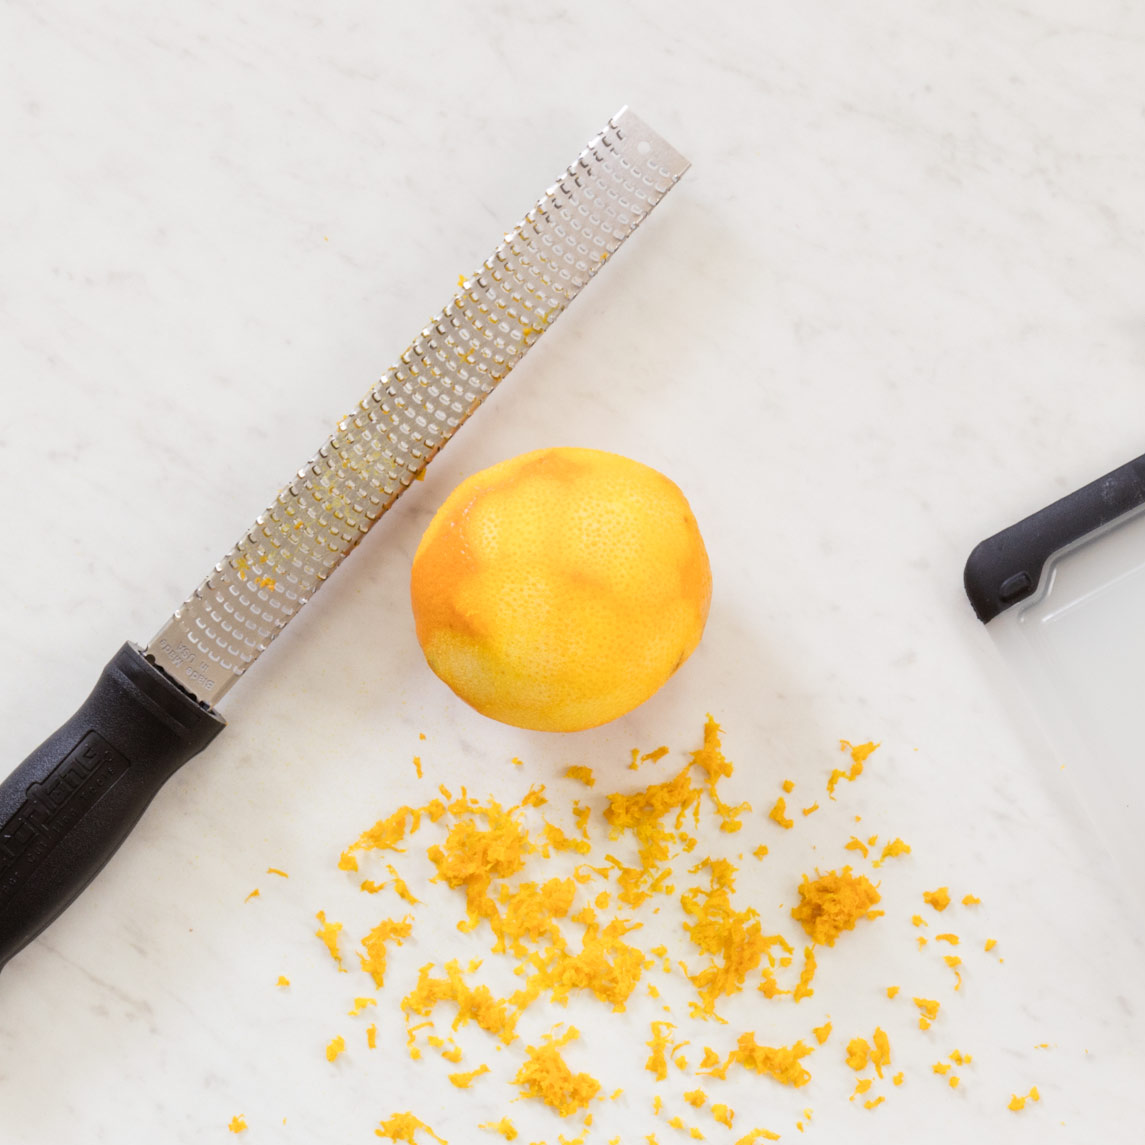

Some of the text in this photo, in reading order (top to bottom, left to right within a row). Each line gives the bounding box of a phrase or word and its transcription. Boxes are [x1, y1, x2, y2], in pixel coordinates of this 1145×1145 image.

[160, 639, 215, 691] Blade Made
[176, 641, 197, 664] USA
